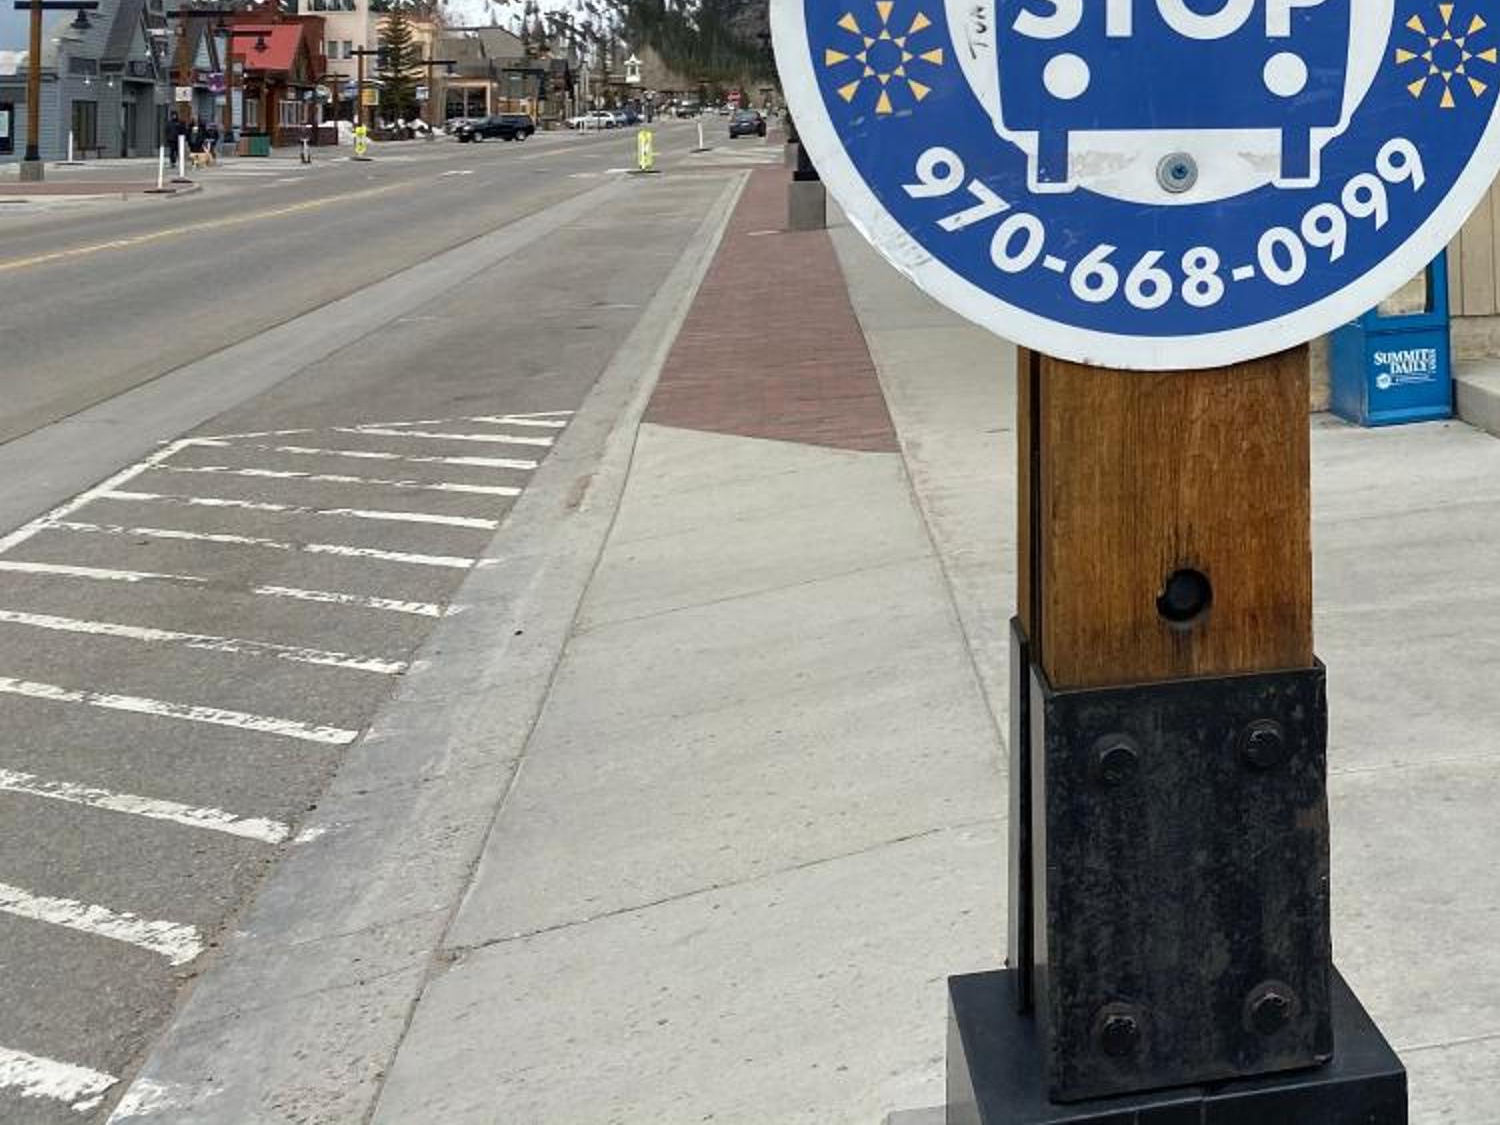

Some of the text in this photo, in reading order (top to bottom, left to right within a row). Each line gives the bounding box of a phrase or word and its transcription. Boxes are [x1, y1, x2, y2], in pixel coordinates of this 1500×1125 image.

[902, 137, 1426, 309] 970-668-0999
[1374, 349, 1430, 366] SUMMIT
[1390, 359, 1428, 374] DAILY
